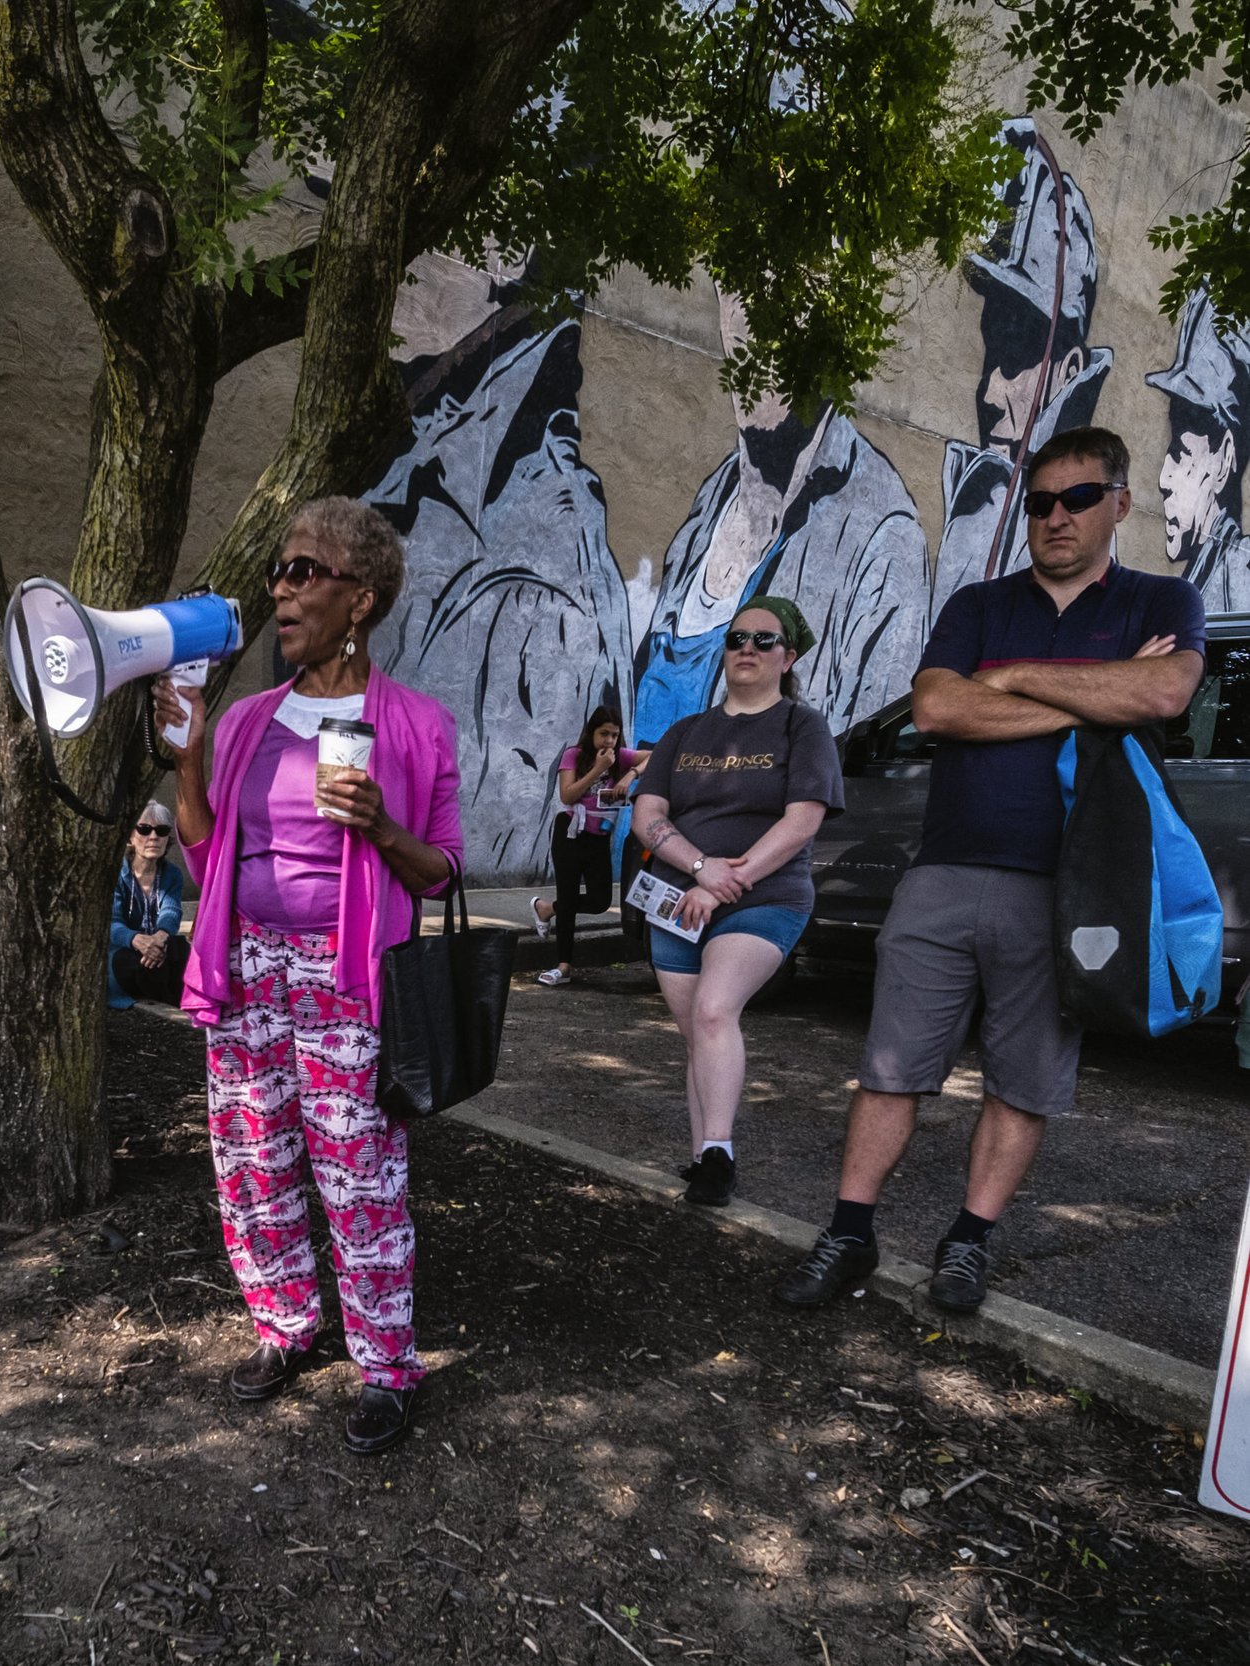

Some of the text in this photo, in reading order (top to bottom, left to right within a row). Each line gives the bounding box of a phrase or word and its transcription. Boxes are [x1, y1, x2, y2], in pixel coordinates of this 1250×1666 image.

[118, 636, 143, 654] PYLE
[675, 752, 712, 772] LORD
[724, 753, 774, 769] RINGS
